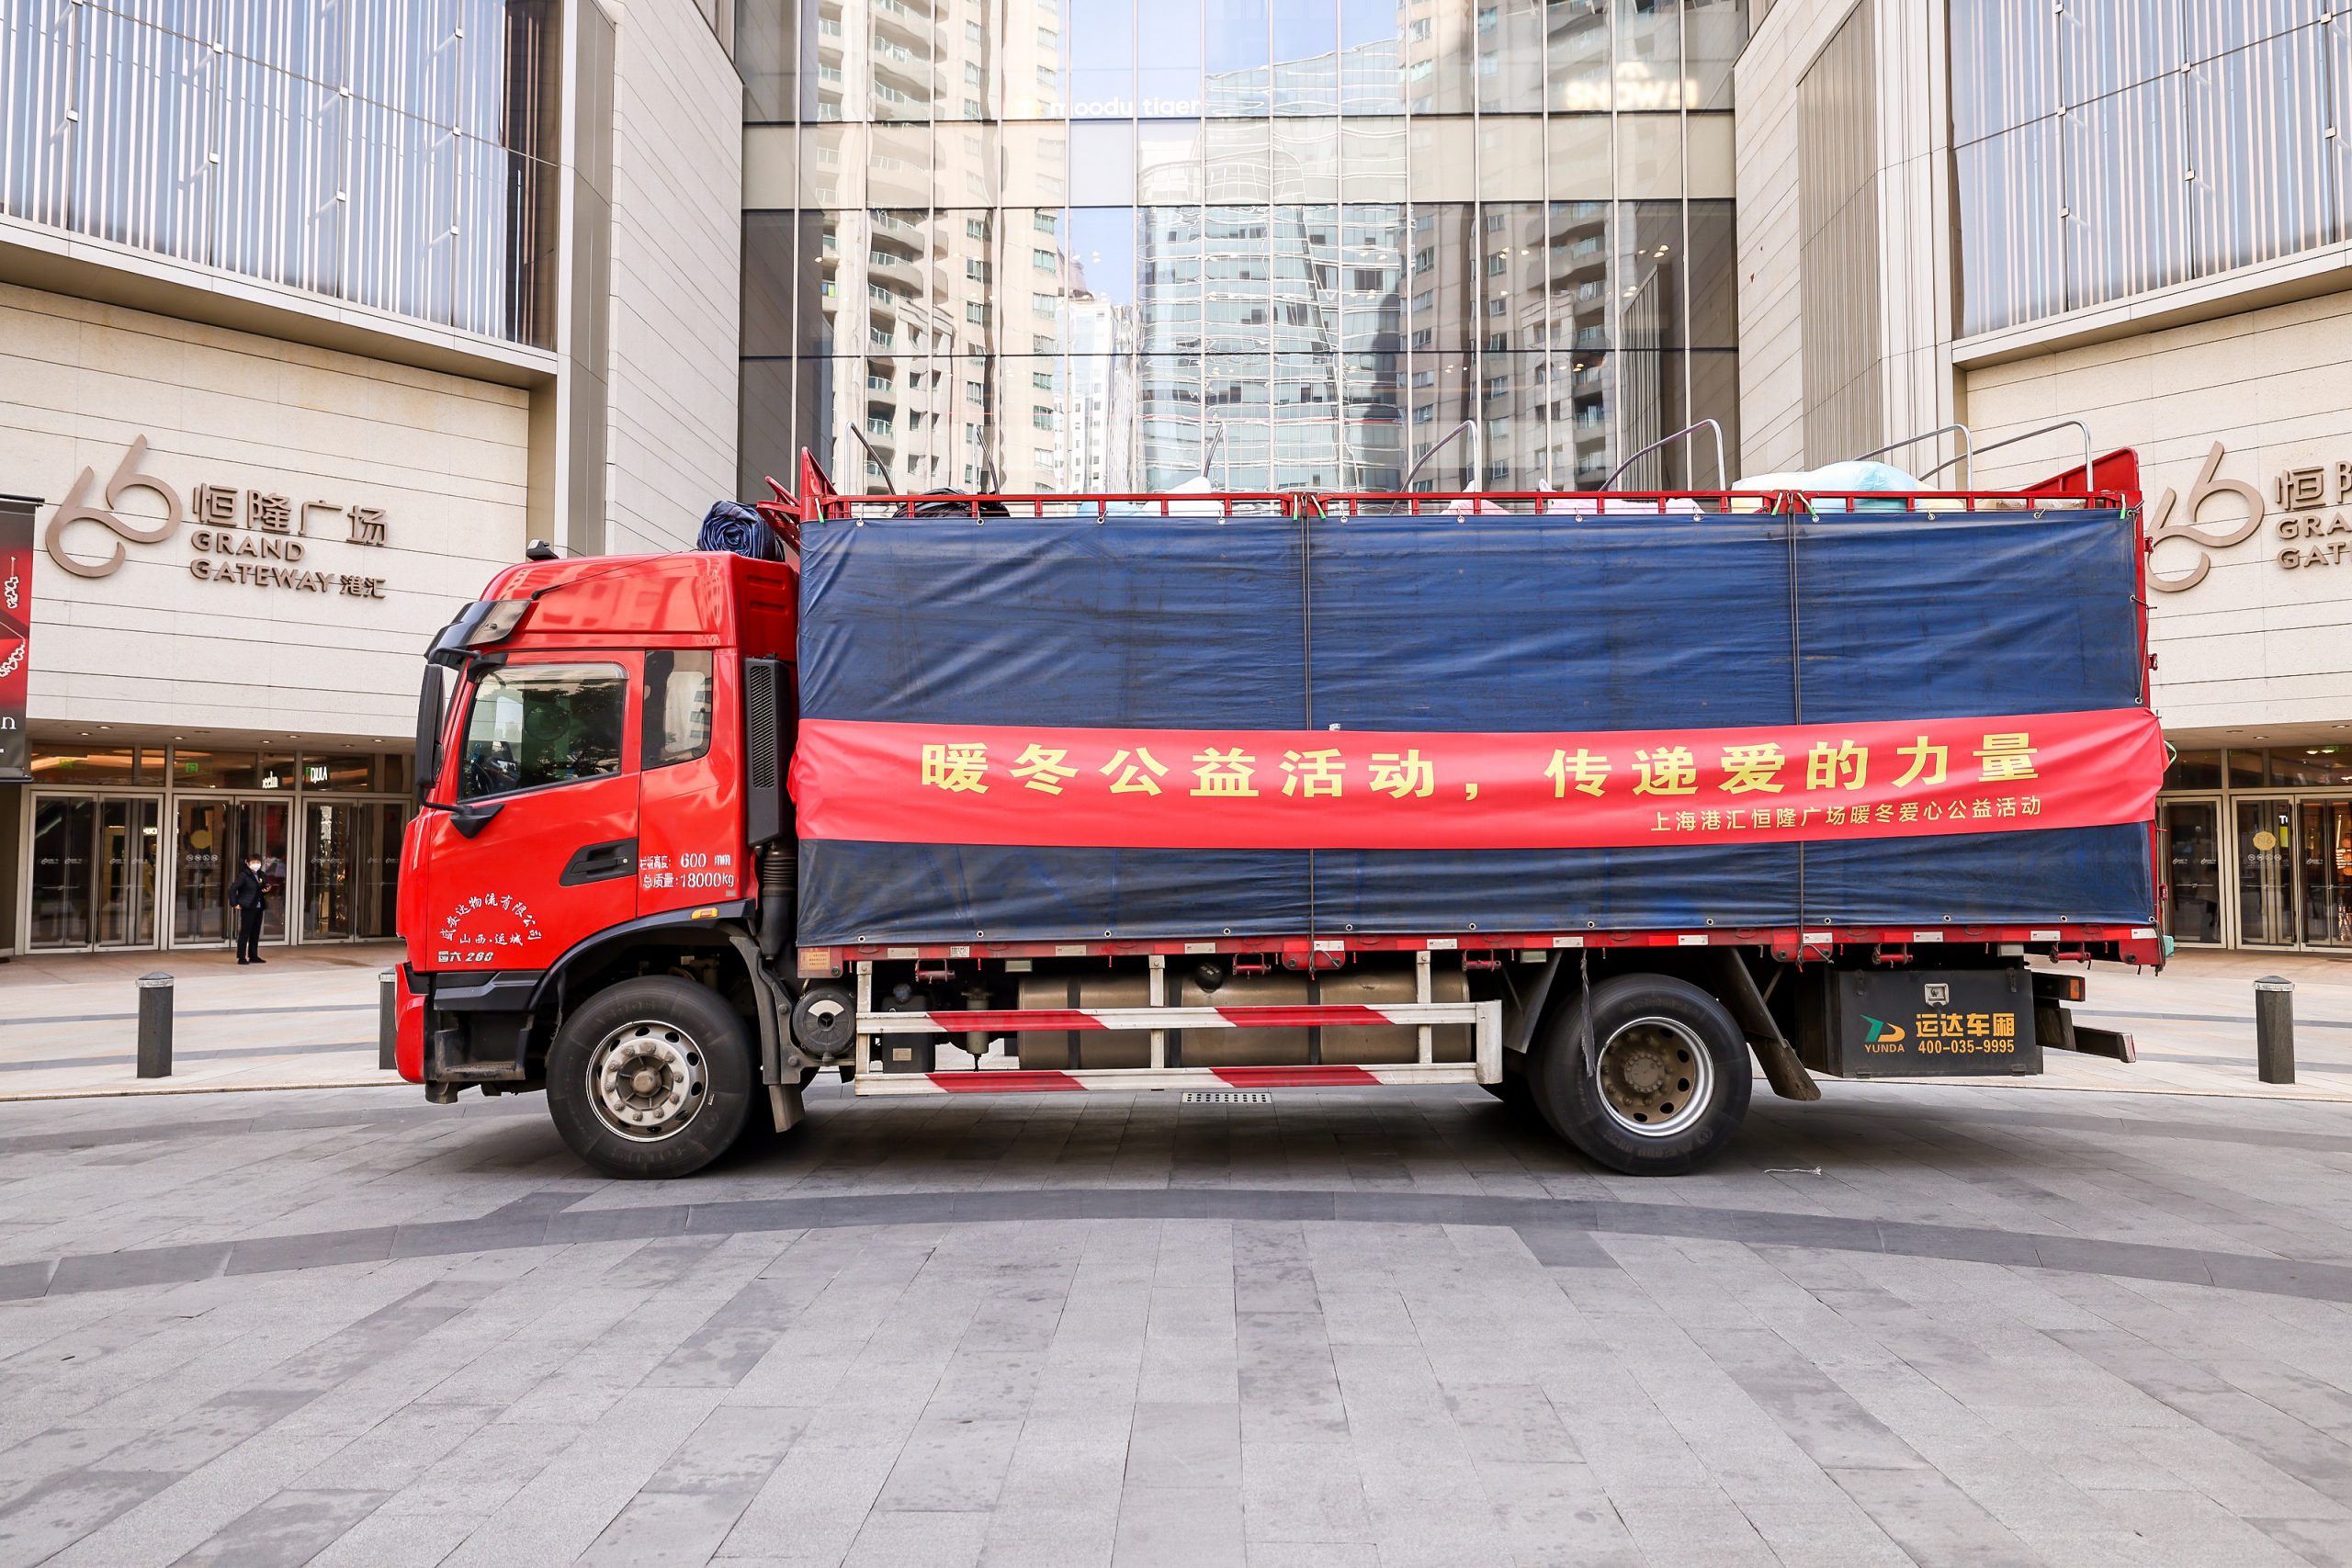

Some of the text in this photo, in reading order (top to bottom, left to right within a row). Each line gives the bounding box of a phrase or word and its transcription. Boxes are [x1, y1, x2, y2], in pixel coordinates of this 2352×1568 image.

[1142, 97, 1201, 118] tiger
[192, 482, 390, 546] 恒隆广场
[191, 529, 306, 561] GRAND
[2277, 541, 2352, 570] GAT
[190, 558, 387, 599] GATEWAY 港汇
[1544, 732, 2041, 797] 传递爱的力量
[1650, 795, 2041, 832] 上海港汇恒隆广场暖冬爱心公益活动
[680, 852, 707, 868] 600
[1915, 1012, 2015, 1037] 运达车厢
[1864, 1043, 1905, 1054] YUNDA
[1917, 1039, 2015, 1054] 400-035-9995
